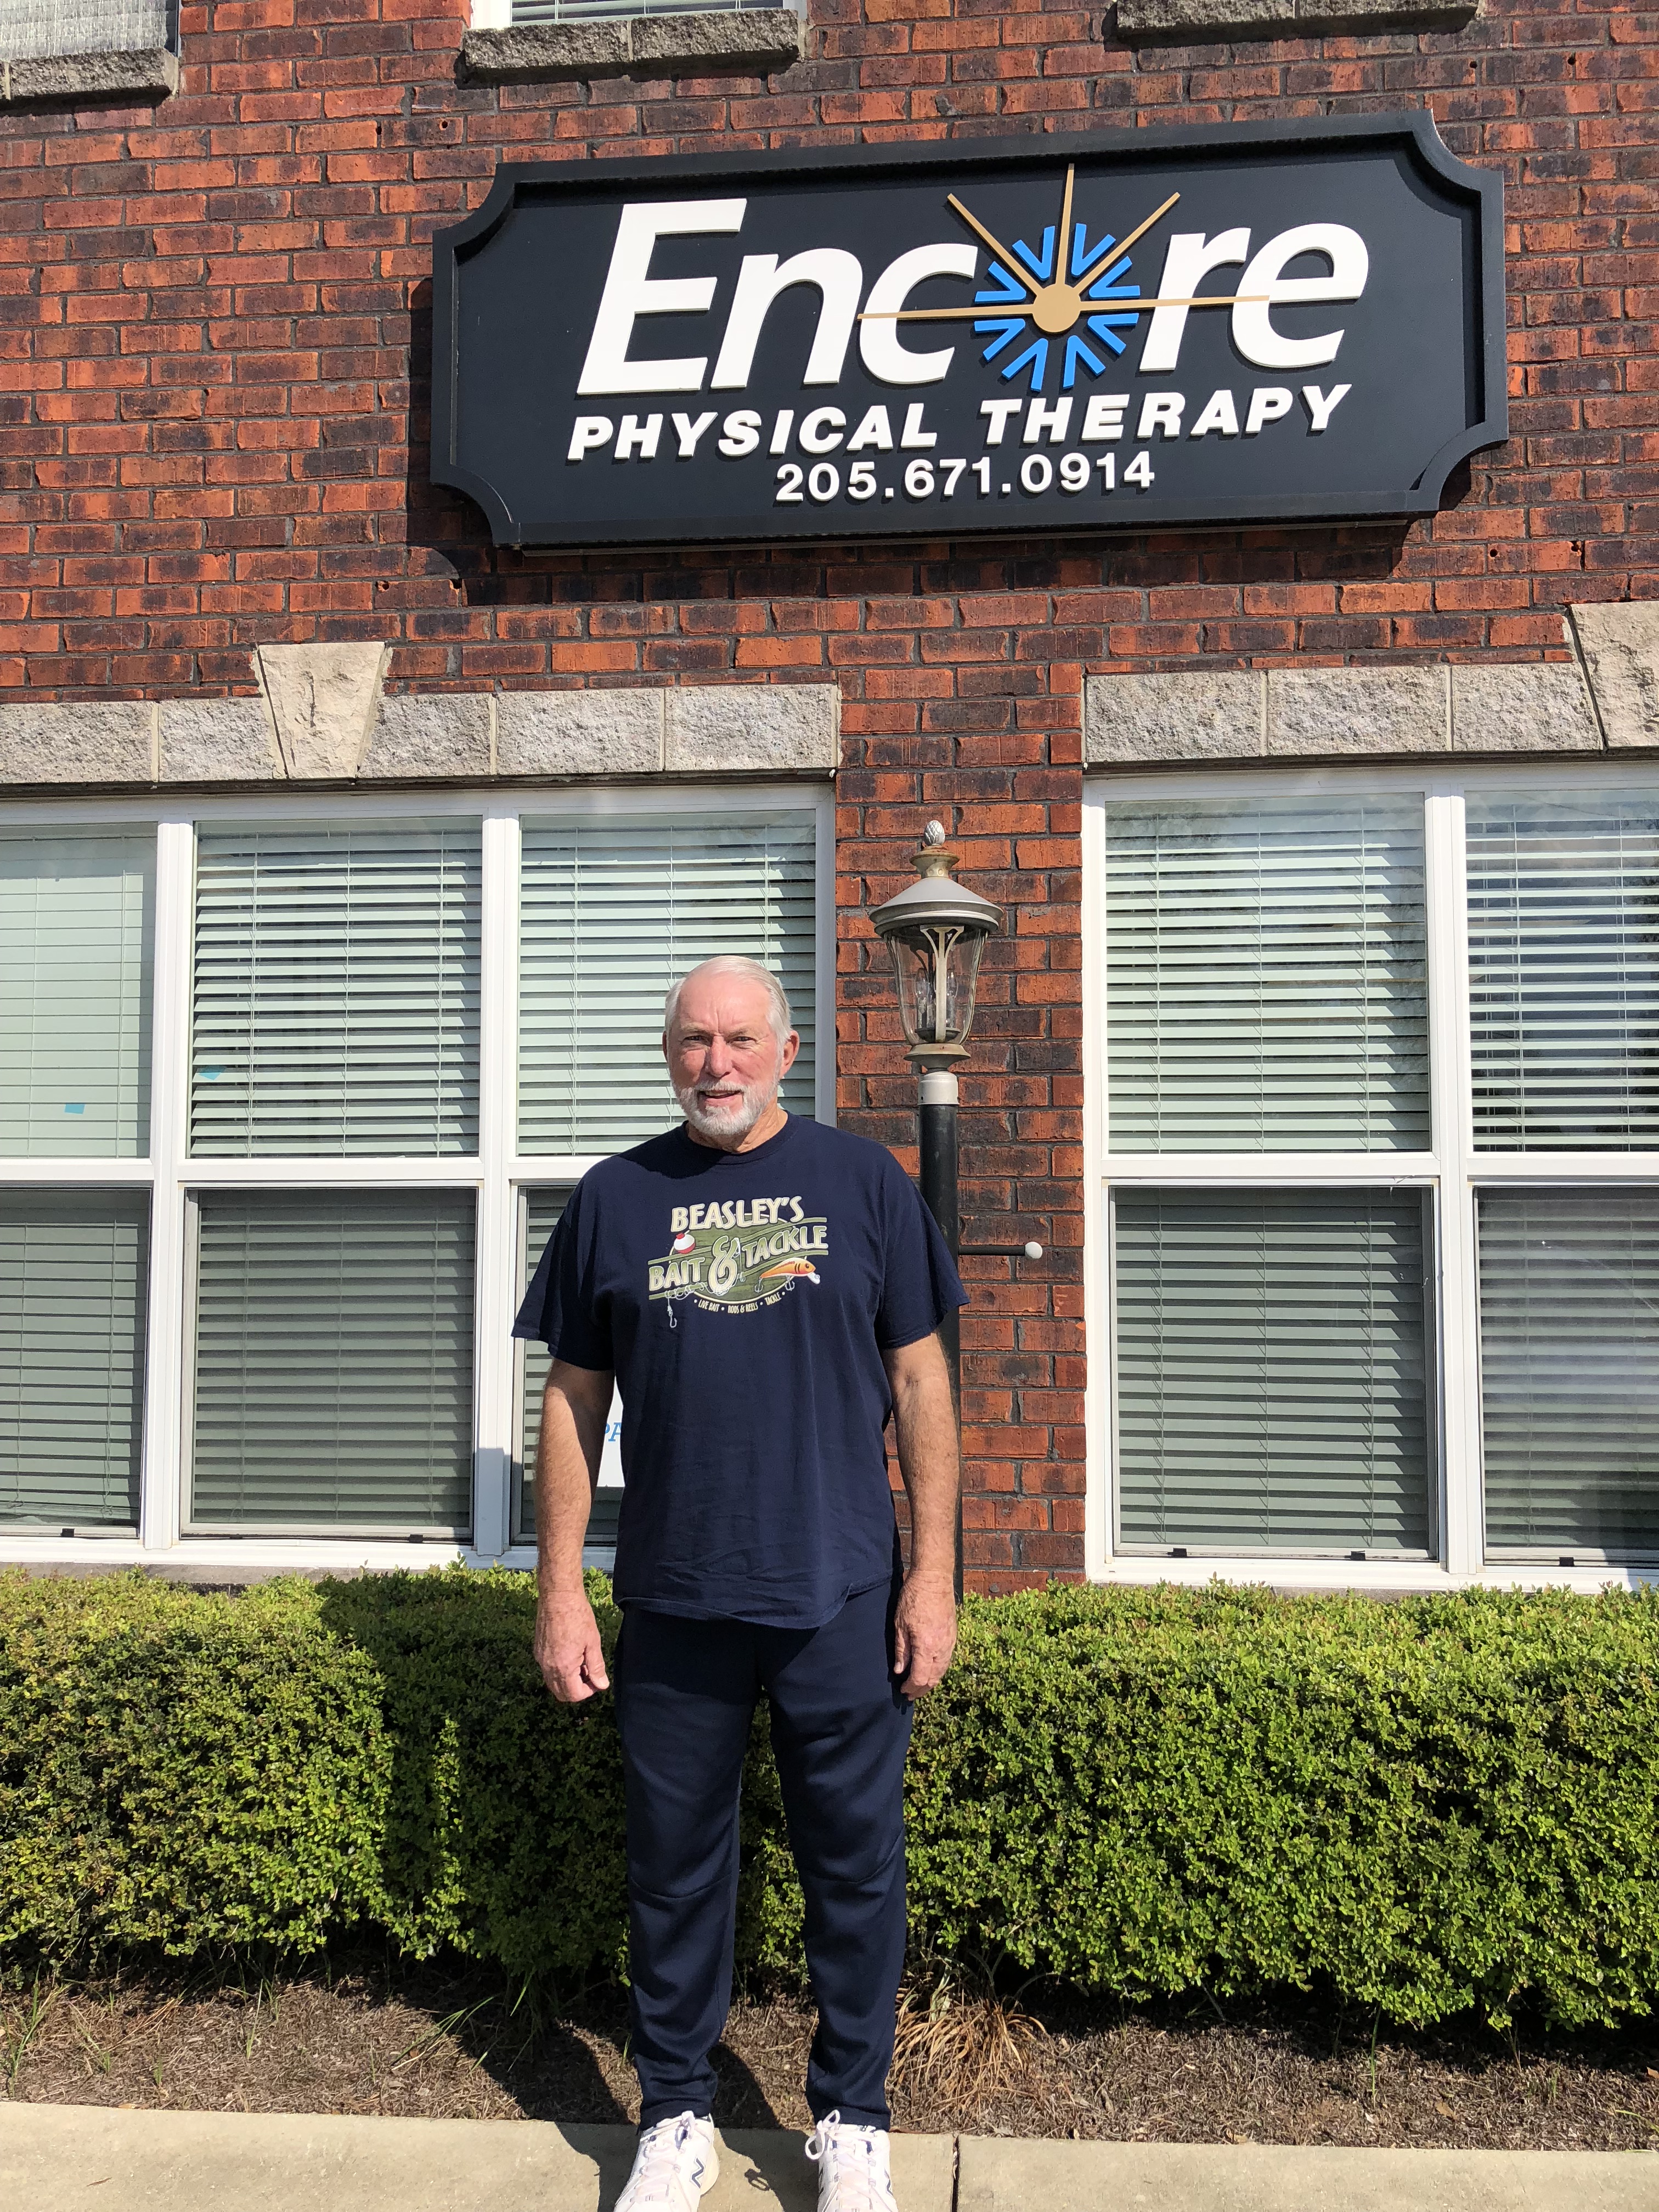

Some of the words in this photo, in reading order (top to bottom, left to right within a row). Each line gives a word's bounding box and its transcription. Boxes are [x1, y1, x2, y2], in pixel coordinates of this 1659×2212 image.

[567, 402, 938, 461] PHYSICAL
[979, 383, 1353, 444] THERAPY
[775, 450, 1155, 502] 205.671.0914
[670, 1195, 804, 1232] BEASLEY'S
[648, 1256, 705, 1291] BAIT
[708, 1235, 741, 1296] &
[742, 1225, 828, 1268] TACKLE
[698, 1299, 708, 1310] LIVE
[708, 1302, 720, 1312] BAIT
[727, 1305, 740, 1314] RODS
[740, 1305, 746, 1313] &
[746, 1302, 759, 1312] REELS
[764, 1292, 782, 1306] TACKLE
